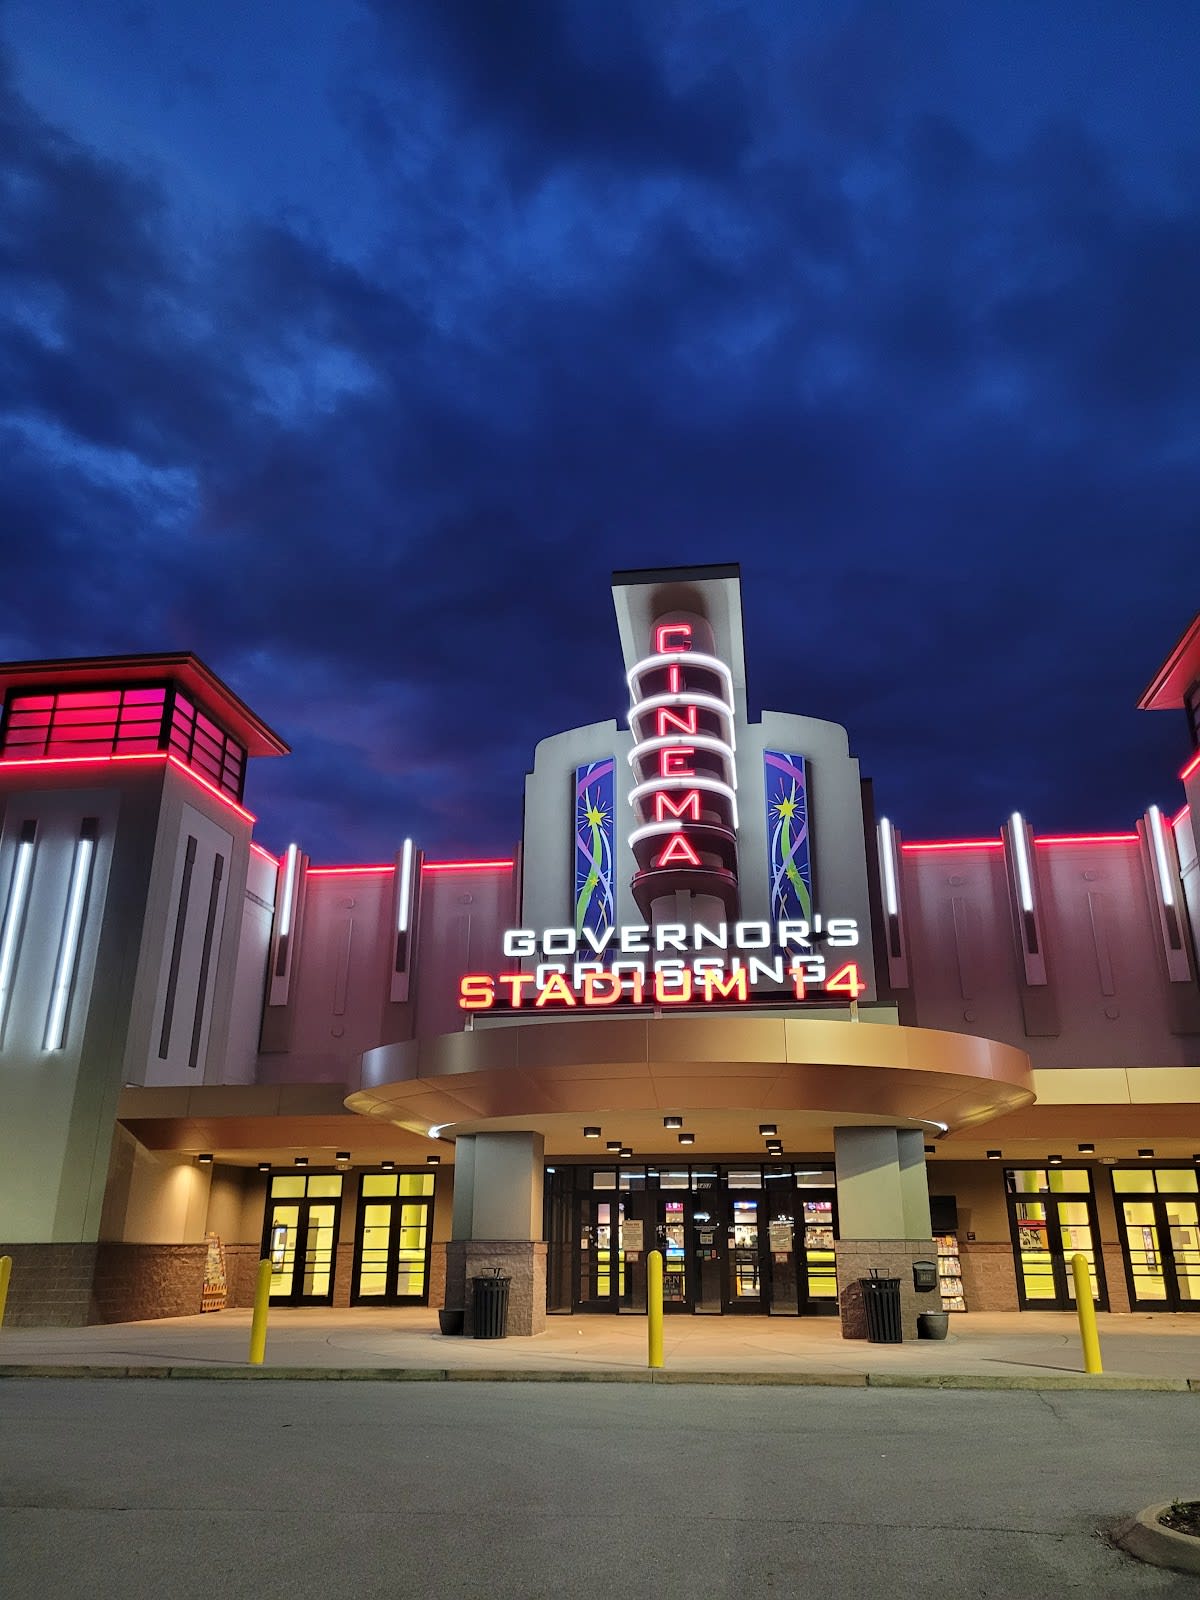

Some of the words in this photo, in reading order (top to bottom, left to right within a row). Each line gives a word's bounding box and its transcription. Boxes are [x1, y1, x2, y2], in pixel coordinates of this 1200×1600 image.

[656, 624, 699, 867] CINEMA
[503, 914, 859, 957] GOVERNOR'S
[459, 969, 747, 1009] STADIUM
[788, 964, 864, 1000] 14
